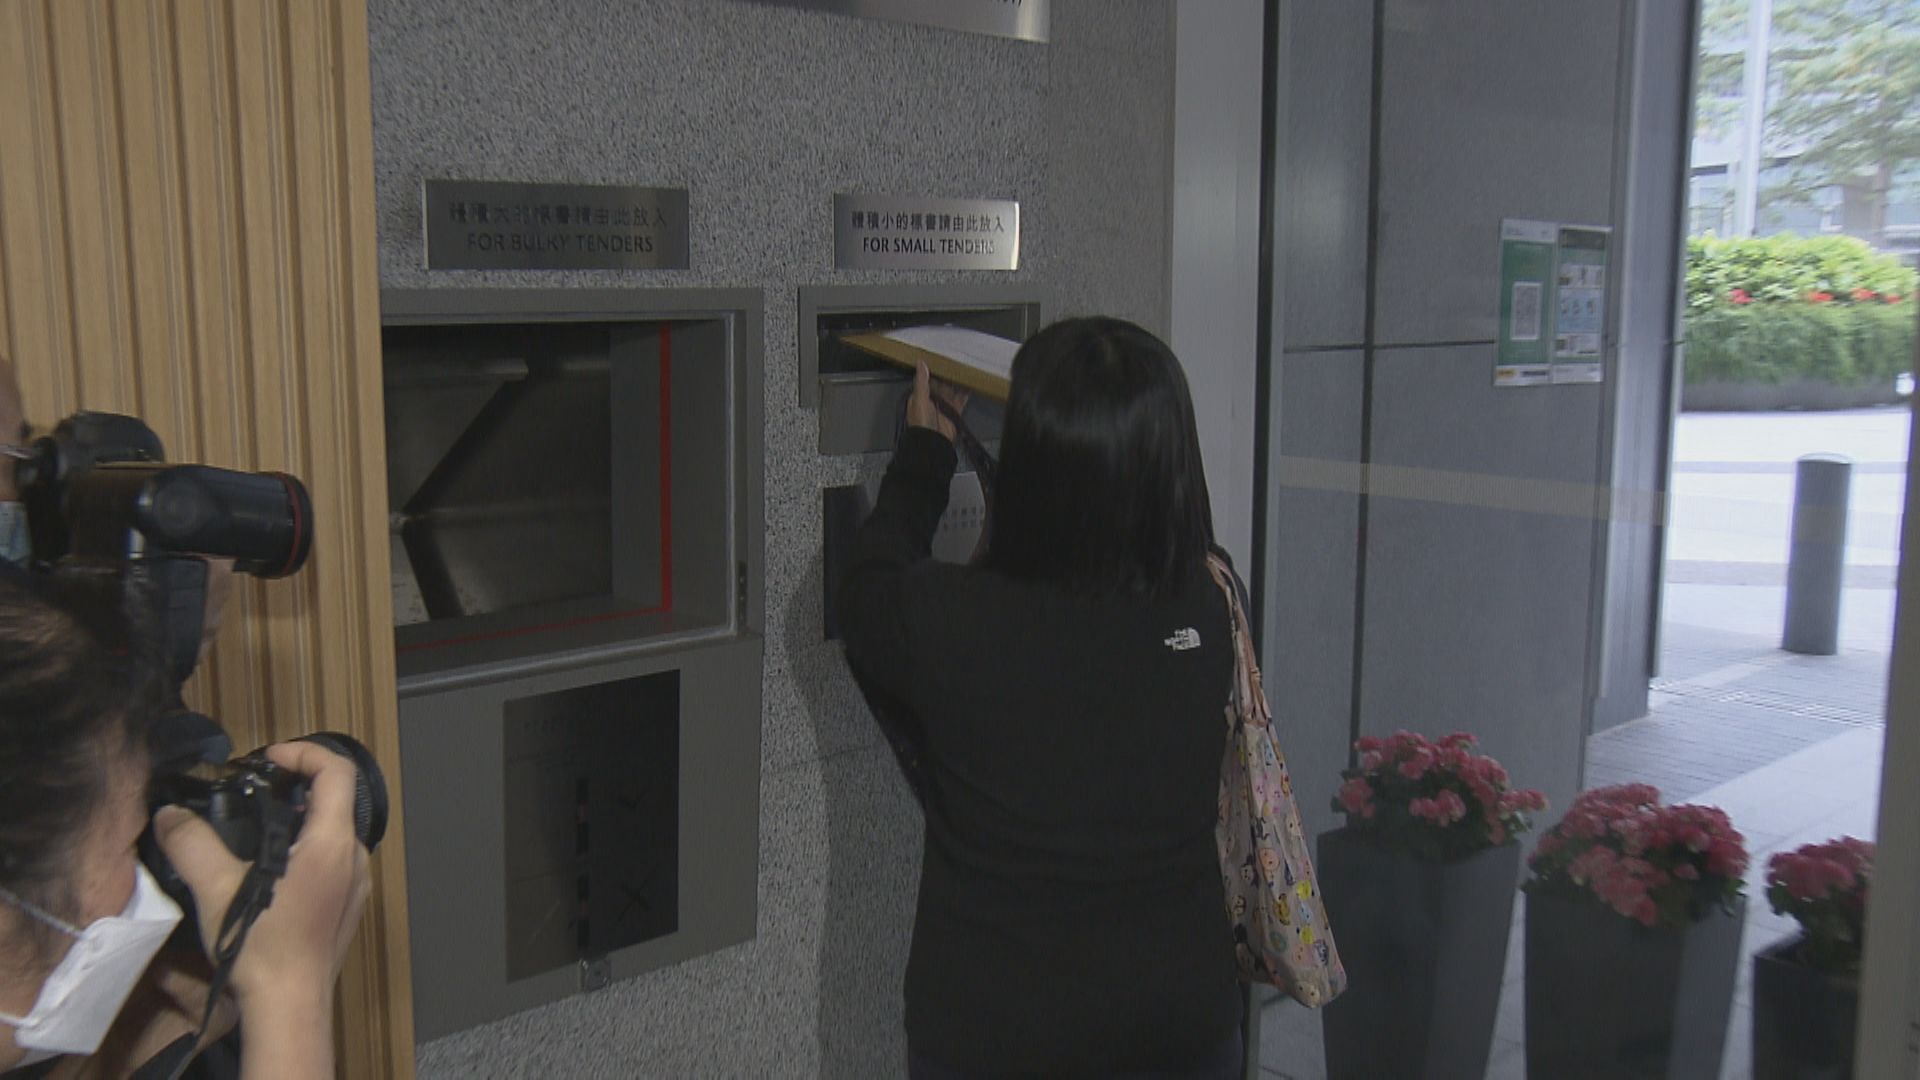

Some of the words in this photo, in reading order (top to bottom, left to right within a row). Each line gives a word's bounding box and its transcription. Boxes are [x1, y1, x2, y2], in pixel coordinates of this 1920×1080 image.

[467, 233, 504, 251] FOR
[512, 233, 569, 252] BULKY
[575, 234, 653, 253] TENDERS
[863, 237, 889, 252] FOR
[894, 238, 935, 253] SMALL
[939, 238, 995, 255] TENDERS
